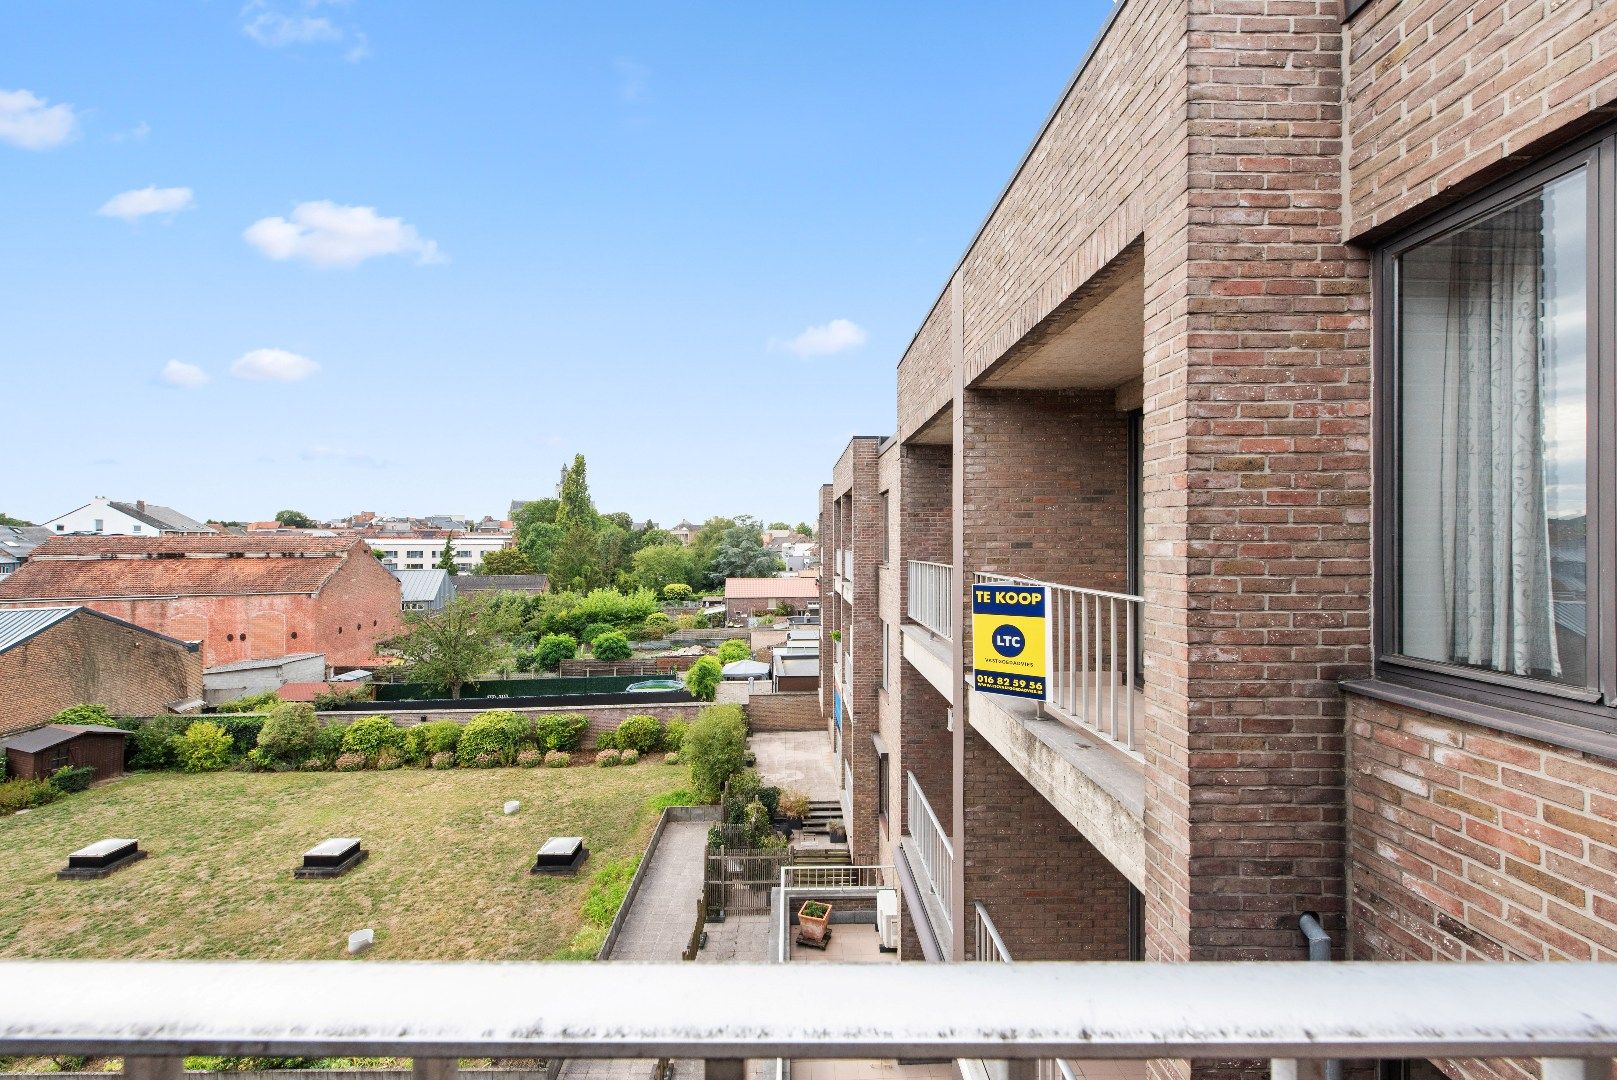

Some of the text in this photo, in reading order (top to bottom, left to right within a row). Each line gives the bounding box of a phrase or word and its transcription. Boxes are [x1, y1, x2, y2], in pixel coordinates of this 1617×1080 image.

[976, 591, 1042, 605] TE KOOP
[996, 635, 1021, 648] LTC
[977, 675, 994, 684] 016
[997, 677, 1010, 686] 82
[1013, 679, 1026, 688] 59
[1029, 681, 1043, 690] 56
